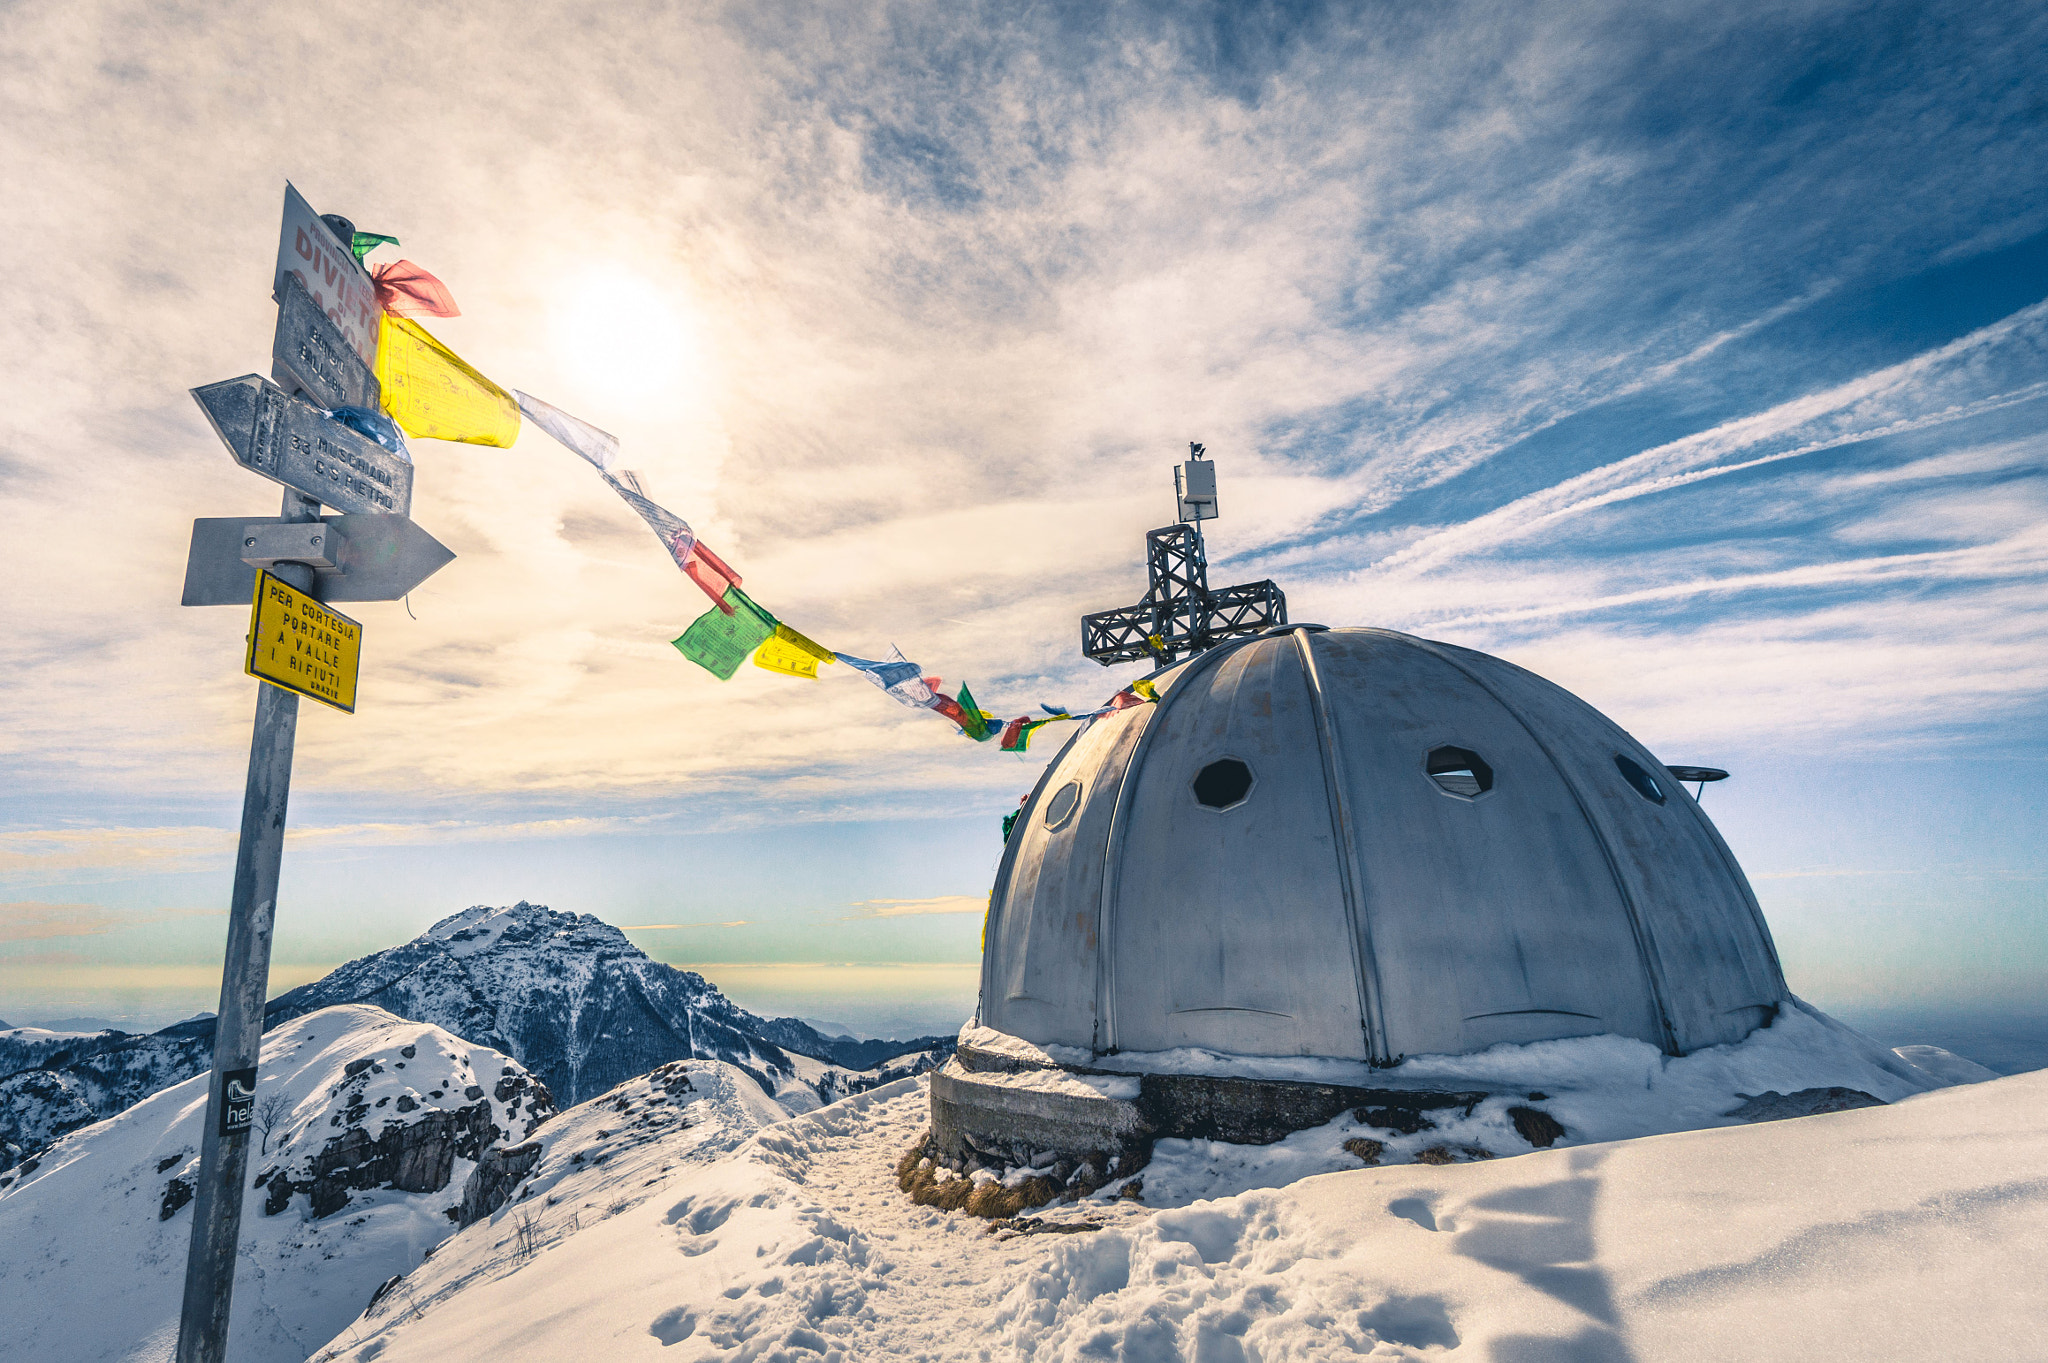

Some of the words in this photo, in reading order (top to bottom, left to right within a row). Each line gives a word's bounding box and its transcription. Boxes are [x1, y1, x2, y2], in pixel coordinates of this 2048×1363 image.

[310, 222, 349, 275] PROVINCIA
[295, 225, 379, 346] DIVIETO
[337, 302, 346, 318] DI
[290, 434, 311, 455] 33
[317, 437, 392, 488] MUSCHIADA
[328, 467, 339, 481] S
[344, 474, 393, 510] PIETRO
[269, 586, 293, 608] PER
[301, 603, 354, 641] CORTESIA
[283, 613, 340, 651] PORTARE
[271, 647, 275, 661] I
[289, 656, 340, 688] RIFIUTI
[277, 631, 285, 645] A
[296, 638, 339, 669] VALLE
[310, 681, 339, 700] GRAZIE
